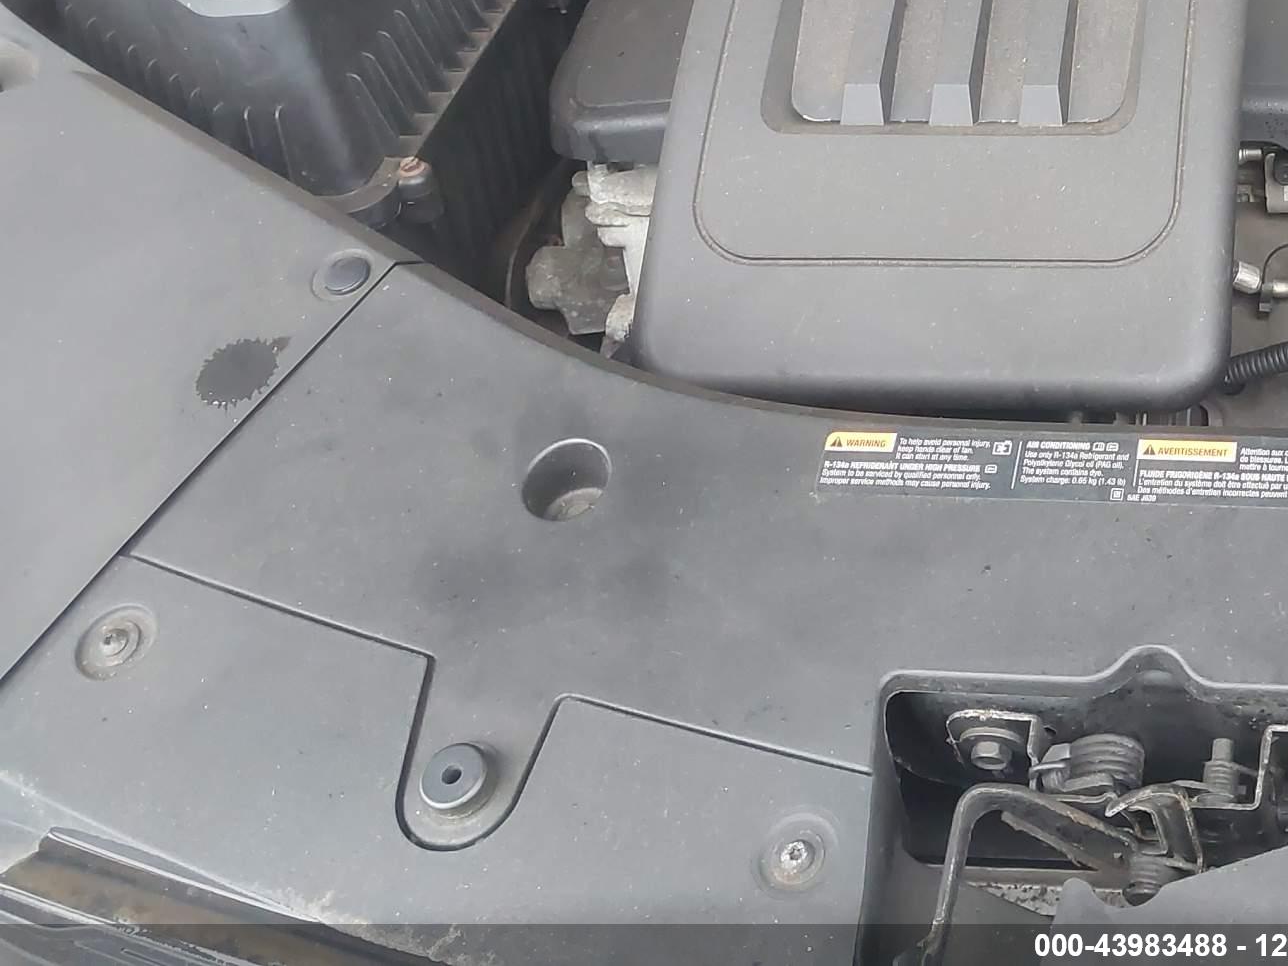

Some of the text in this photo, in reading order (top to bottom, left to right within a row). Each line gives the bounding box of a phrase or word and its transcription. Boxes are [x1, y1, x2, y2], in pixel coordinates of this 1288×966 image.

[846, 439, 886, 447] WARNING
[1041, 442, 1090, 450] CONDITIONING
[1158, 447, 1227, 456] AVERTISSEMENT
